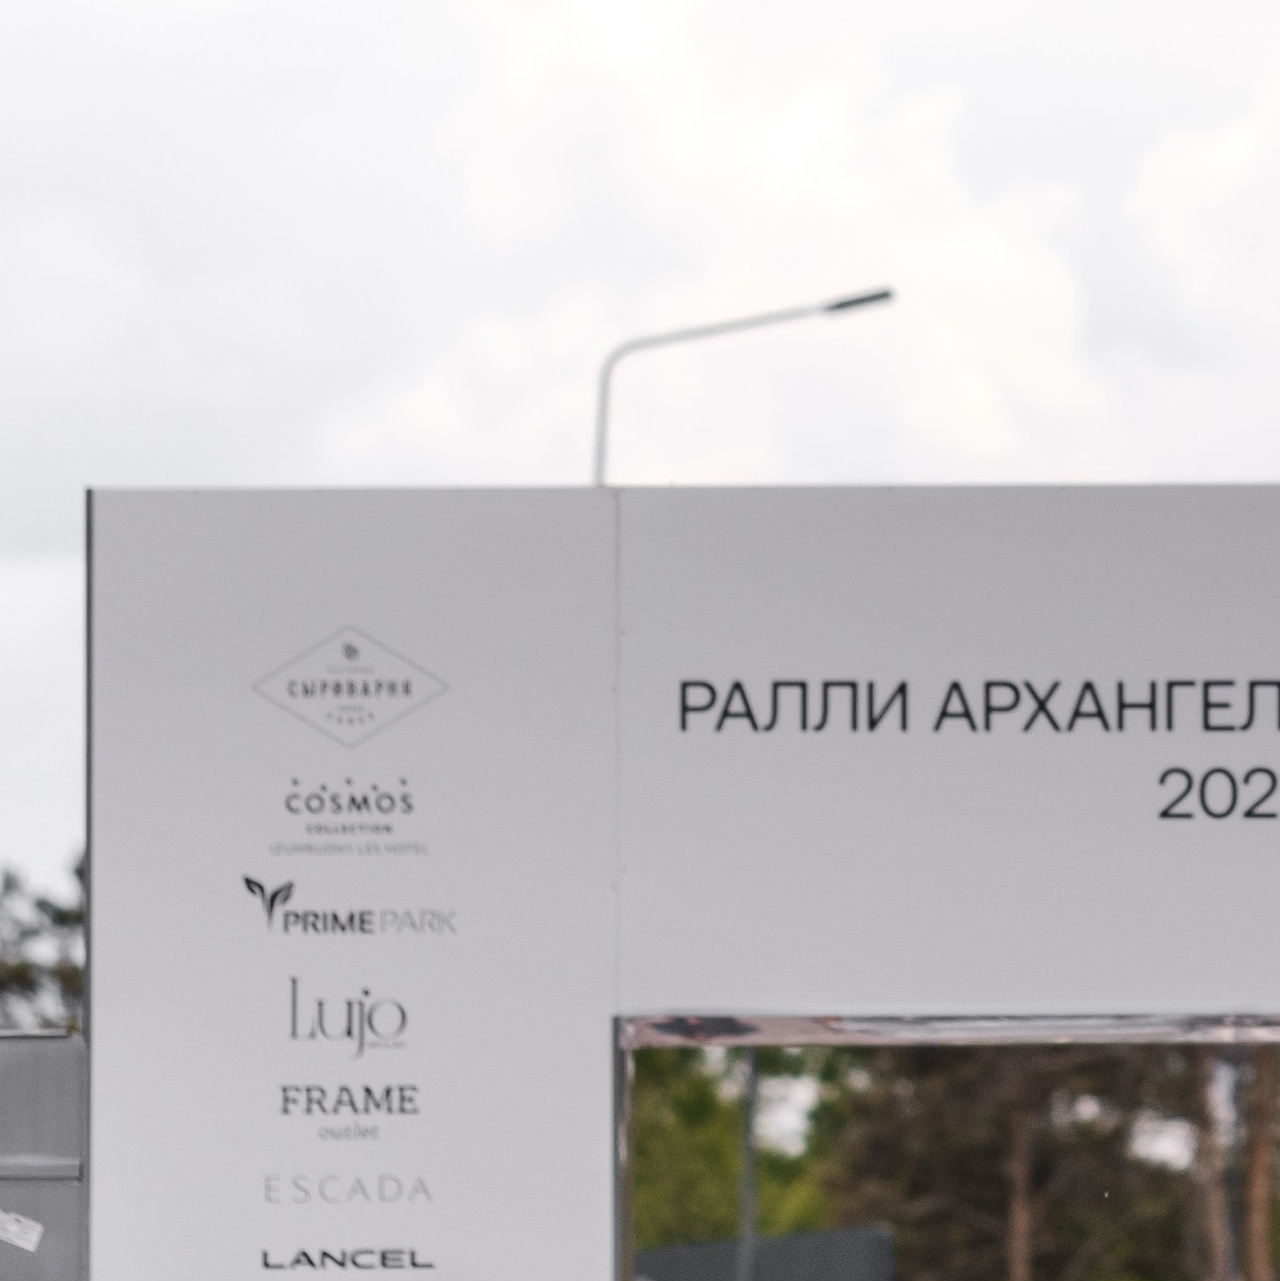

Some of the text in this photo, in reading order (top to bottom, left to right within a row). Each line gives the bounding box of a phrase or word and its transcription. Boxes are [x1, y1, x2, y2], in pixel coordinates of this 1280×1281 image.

[680, 680, 908, 732] РАЛЛИ
[284, 792, 414, 815] COSMOS
[304, 822, 394, 836] COLLECTION
[290, 976, 407, 1057] Lujo
[281, 1085, 418, 1116] FRAME
[318, 1122, 379, 1140] outlet
[264, 1173, 433, 1204] ESCADA
[261, 1249, 435, 1269] LANCEL
